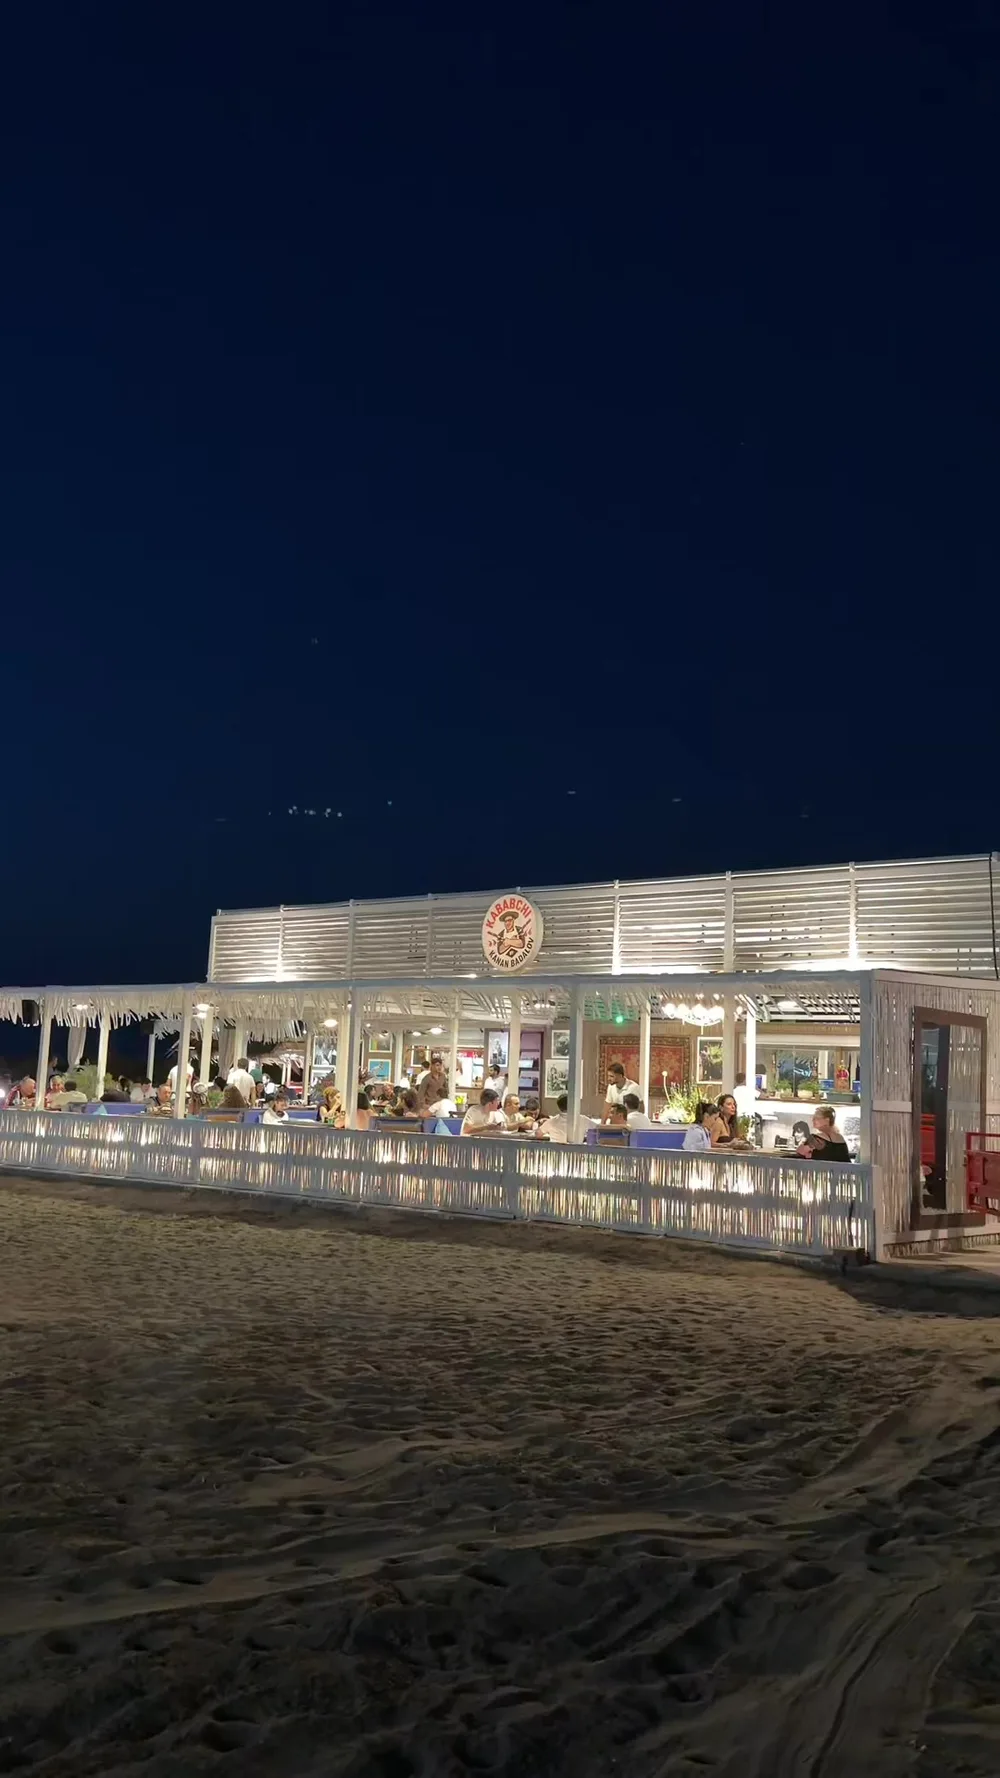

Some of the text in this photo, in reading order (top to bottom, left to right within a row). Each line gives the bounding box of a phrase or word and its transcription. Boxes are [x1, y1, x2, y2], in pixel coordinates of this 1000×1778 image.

[486, 898, 532, 928] KABABCHI
[489, 937, 534, 968] KANAN BADALOV
